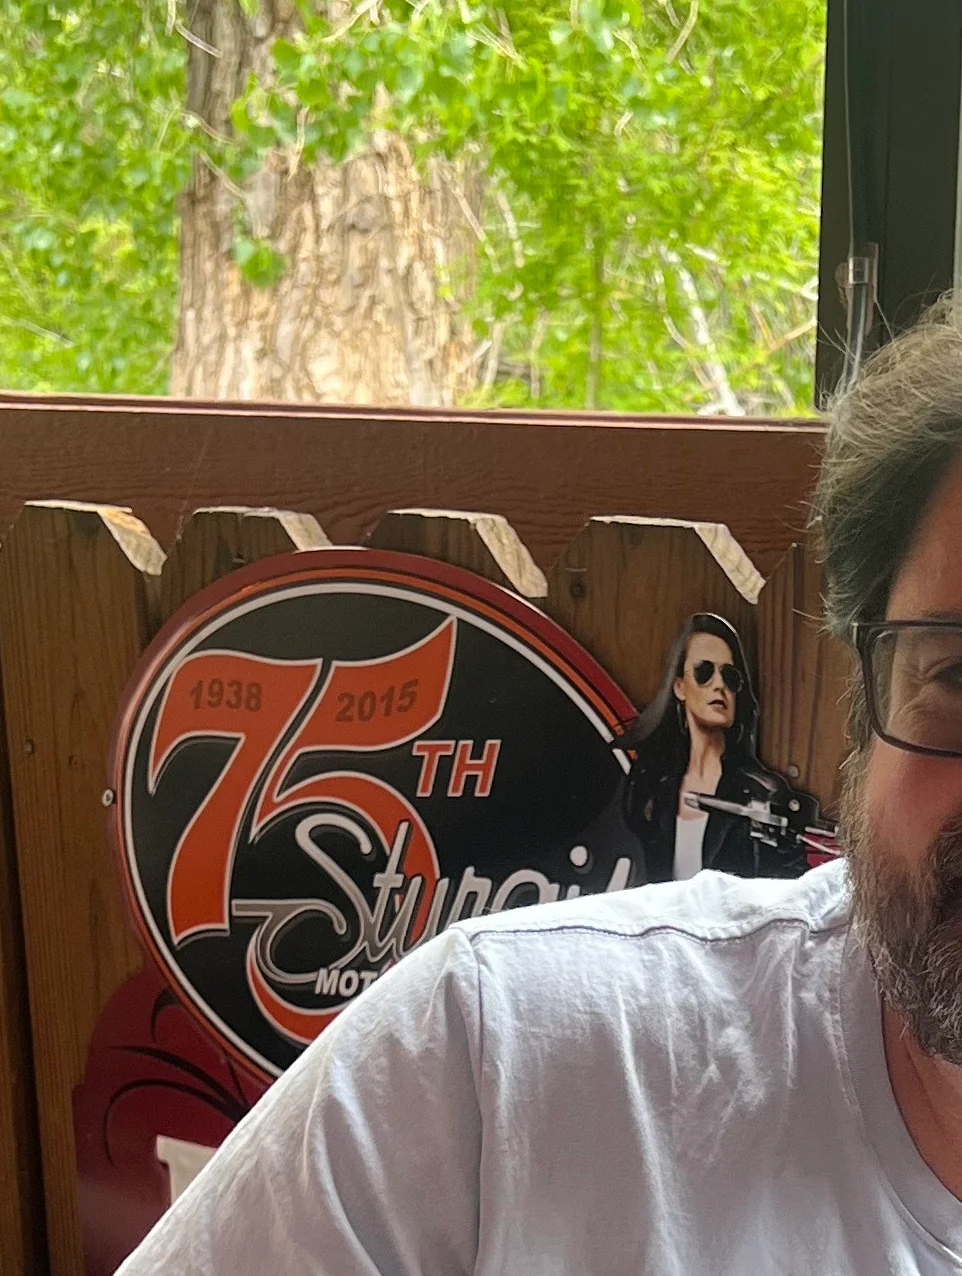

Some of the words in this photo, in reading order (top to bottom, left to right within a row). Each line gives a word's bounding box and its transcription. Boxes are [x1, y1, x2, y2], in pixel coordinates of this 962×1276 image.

[188, 677, 263, 713] 1938
[334, 678, 419, 723] 2015
[232, 812, 631, 983] Stur
